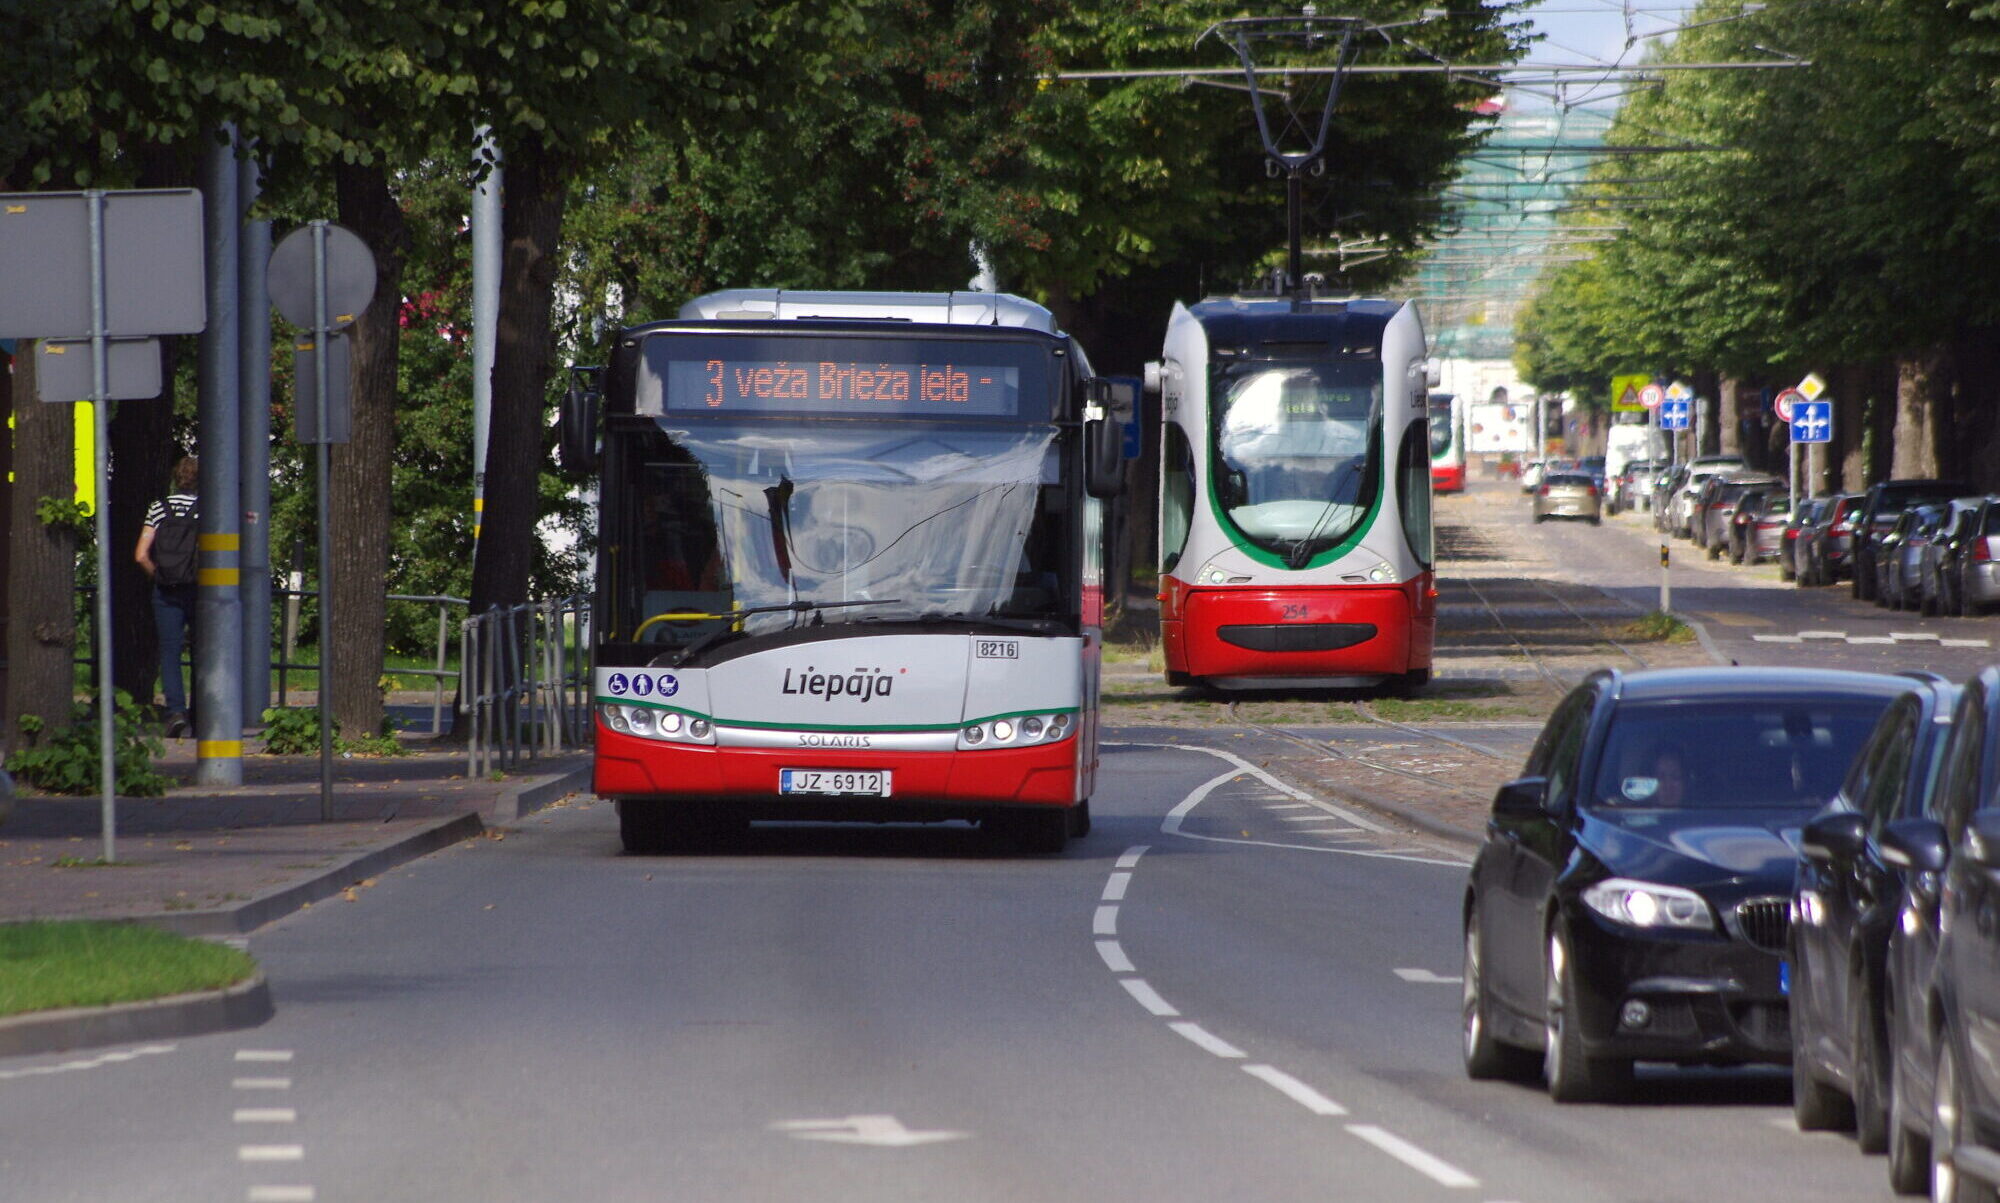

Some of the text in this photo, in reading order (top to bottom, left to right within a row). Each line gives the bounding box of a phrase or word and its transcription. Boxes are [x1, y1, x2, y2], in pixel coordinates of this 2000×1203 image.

[706, 360, 724, 406] 3
[735, 361, 808, 398] veža
[819, 361, 909, 400] Brieža
[920, 364, 968, 402] iela
[1282, 604, 1308, 619] 254
[980, 642, 1016, 657] 8216
[782, 666, 894, 703] Liepāja
[798, 734, 871, 748] SOLARIS
[796, 773, 879, 790] JZ-6912
